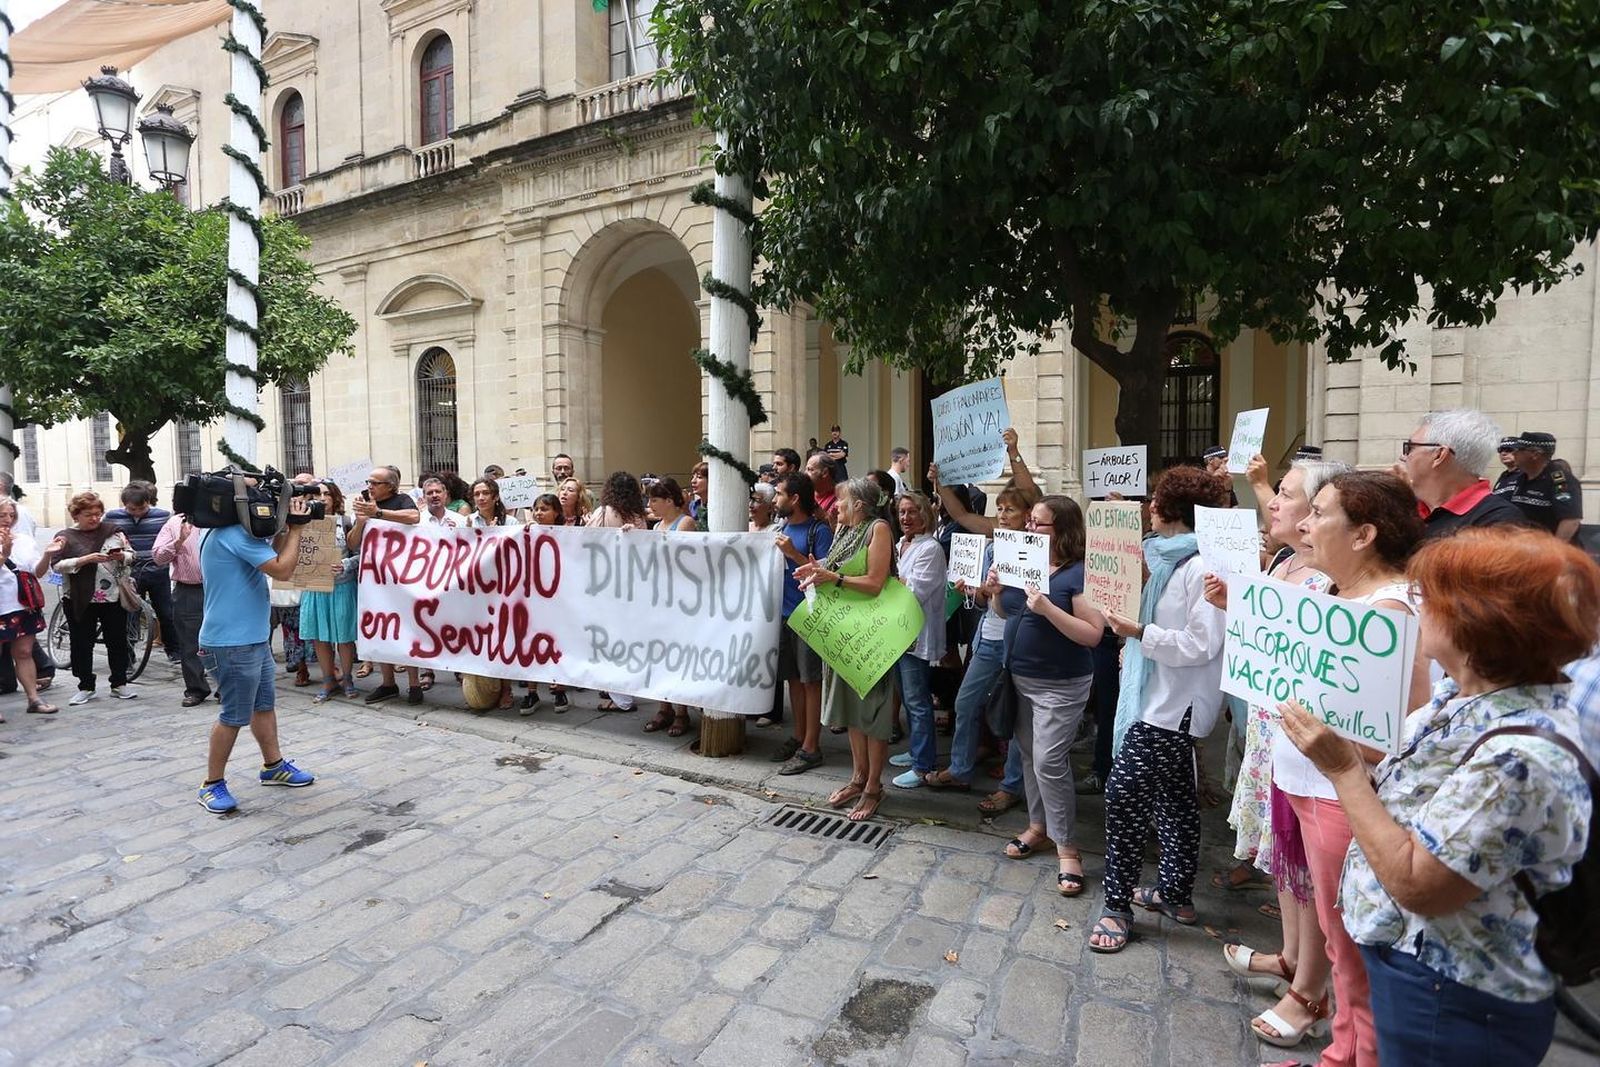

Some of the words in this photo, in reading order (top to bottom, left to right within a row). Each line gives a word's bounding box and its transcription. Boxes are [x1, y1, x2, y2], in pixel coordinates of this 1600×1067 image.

[979, 409, 1003, 436] YA!
[1088, 508, 1102, 528] NO
[1104, 508, 1140, 531] ESTAMOS
[582, 535, 777, 623] DIMISIÓN
[360, 610, 400, 641] en
[409, 598, 562, 668] Sevilla
[584, 625, 779, 690] Responsables
[1227, 619, 1361, 693] ALCORQUES
[1242, 584, 1398, 658] 10.000
[1227, 653, 1303, 703] VACÍOS
[1318, 692, 1393, 749] Sevilla!
